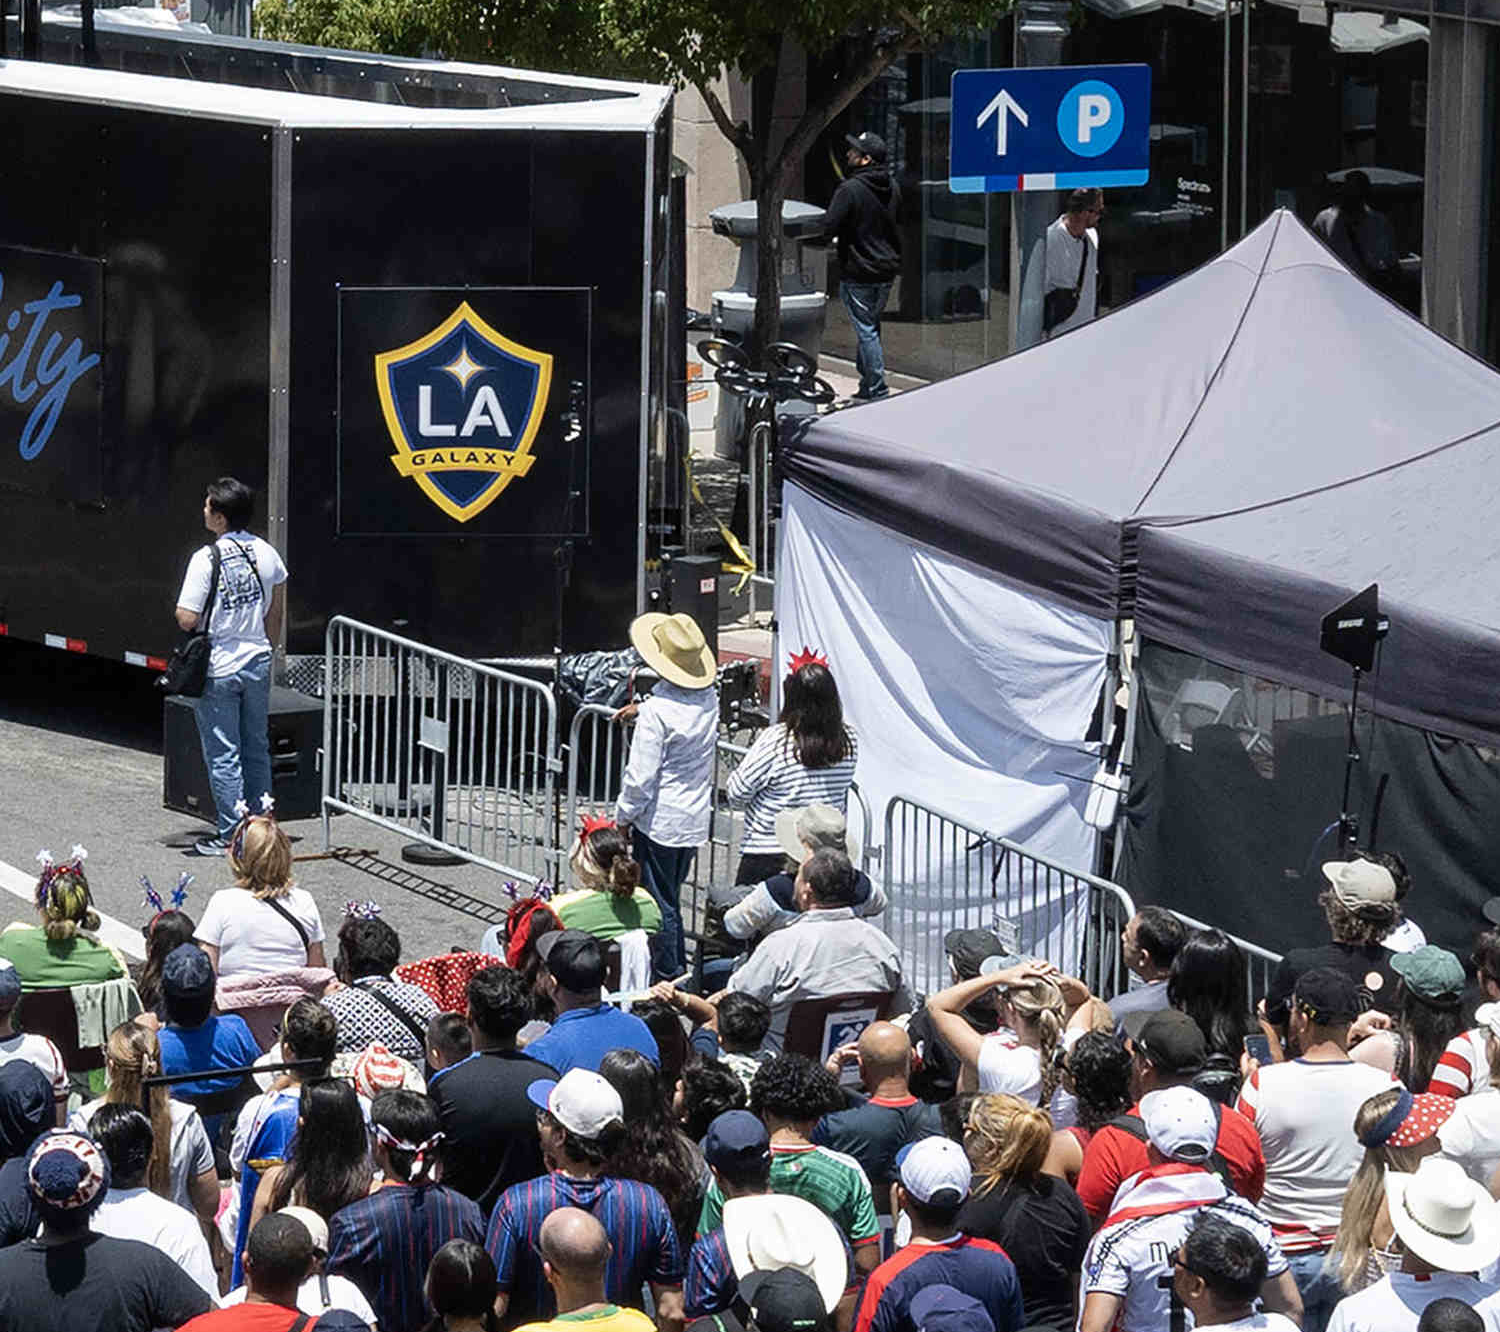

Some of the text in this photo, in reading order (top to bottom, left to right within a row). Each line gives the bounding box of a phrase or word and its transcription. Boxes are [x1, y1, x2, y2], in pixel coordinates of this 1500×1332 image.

[1077, 93, 1112, 143] P
[418, 384, 512, 438] LA
[411, 450, 515, 466] GALAXY
